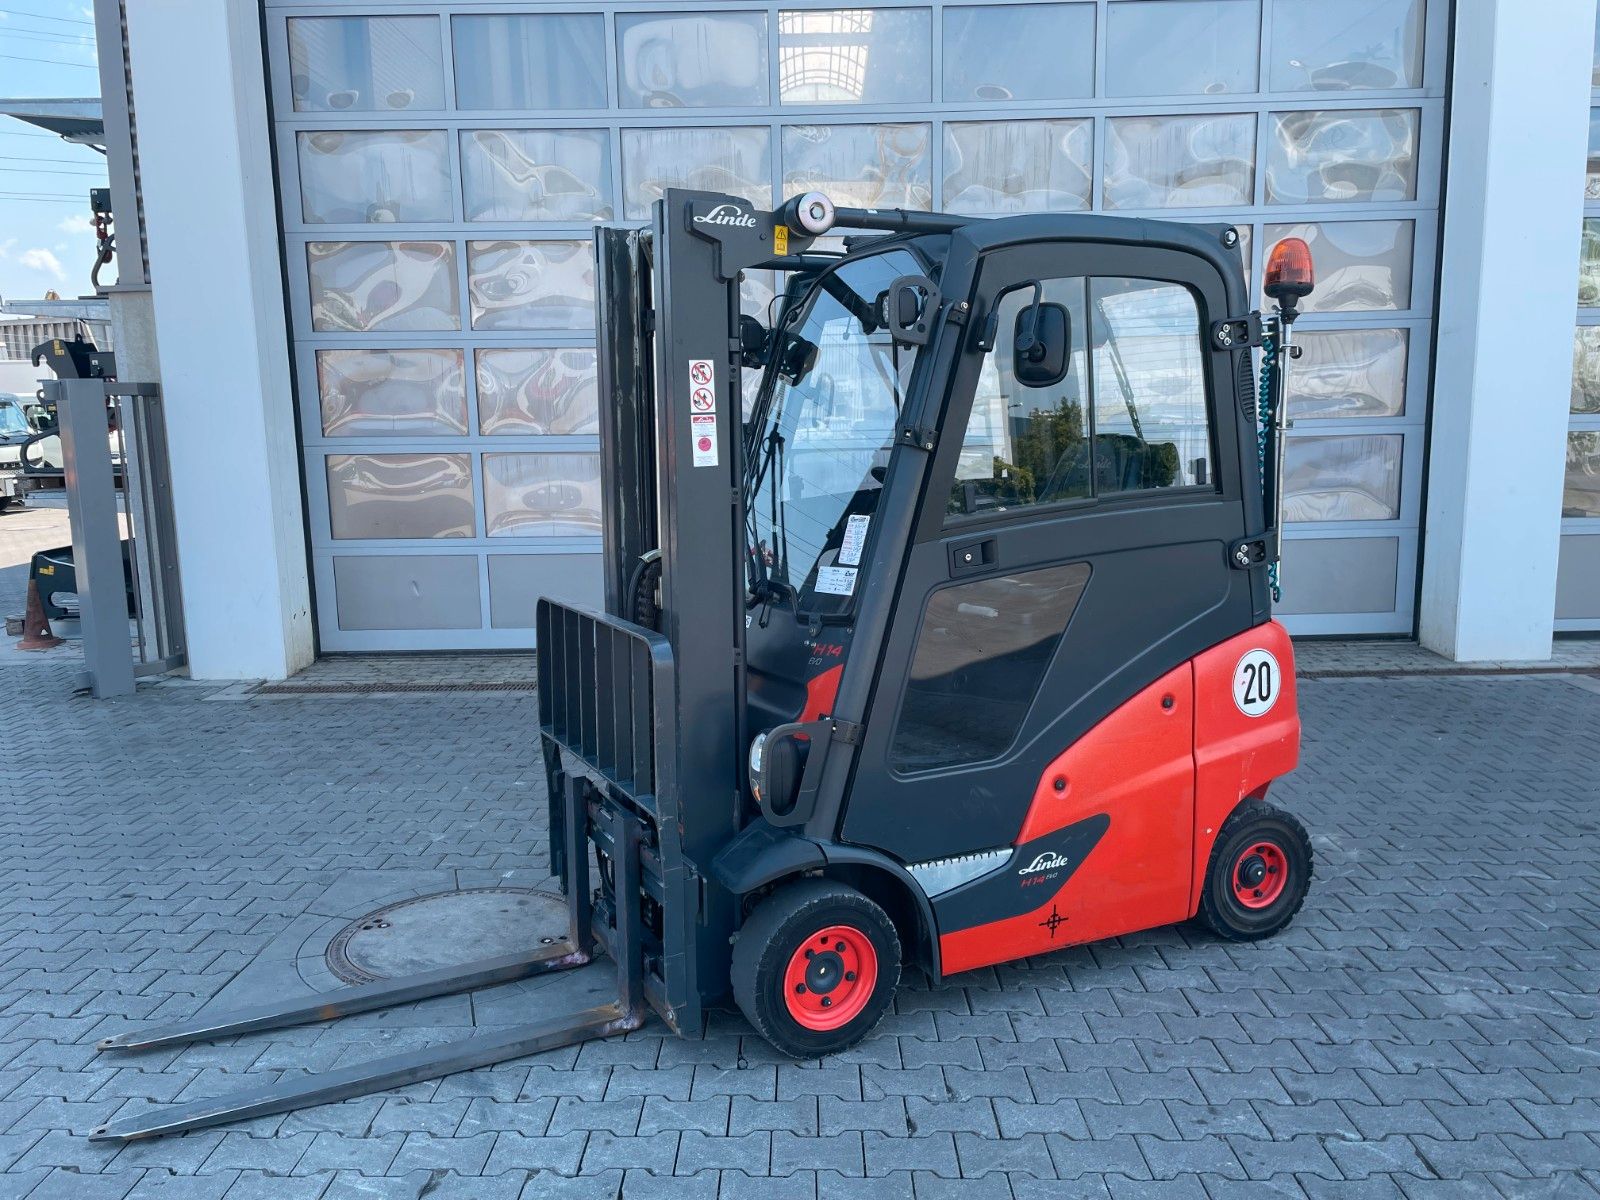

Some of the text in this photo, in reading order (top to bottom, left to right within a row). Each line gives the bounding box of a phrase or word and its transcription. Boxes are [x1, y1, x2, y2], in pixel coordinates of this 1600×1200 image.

[693, 204, 756, 228] Linde
[813, 644, 843, 657] H14
[1243, 661, 1271, 705] 20
[1018, 851, 1068, 875] Linde
[1021, 875, 1045, 888] H14
